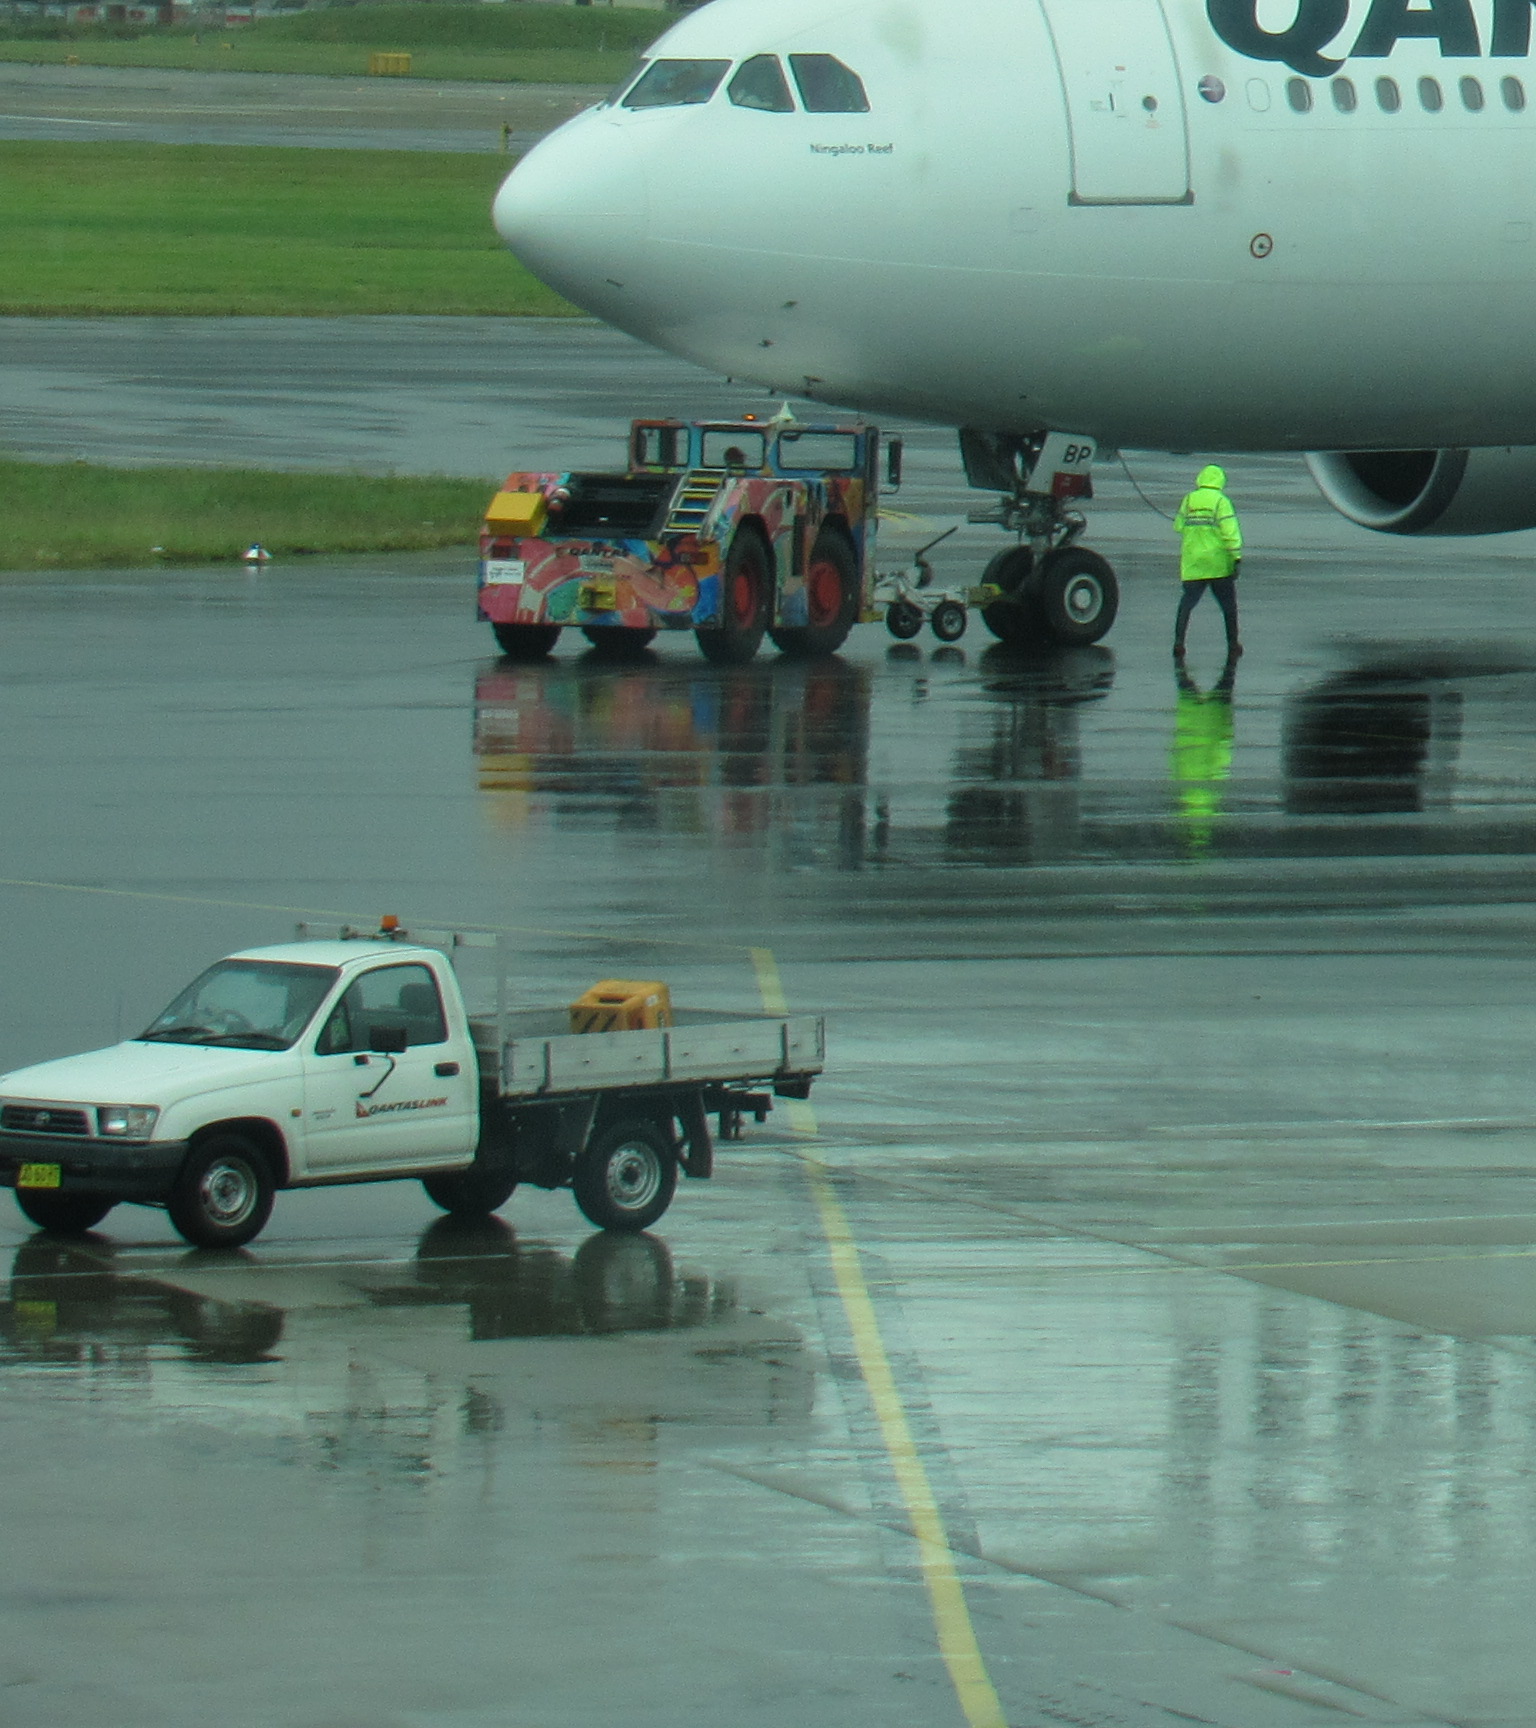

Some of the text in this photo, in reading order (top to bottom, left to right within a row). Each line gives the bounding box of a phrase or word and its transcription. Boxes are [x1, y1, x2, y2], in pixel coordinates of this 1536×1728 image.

[809, 143, 894, 157] Ningaloo Reef
[1063, 444, 1092, 464] BP
